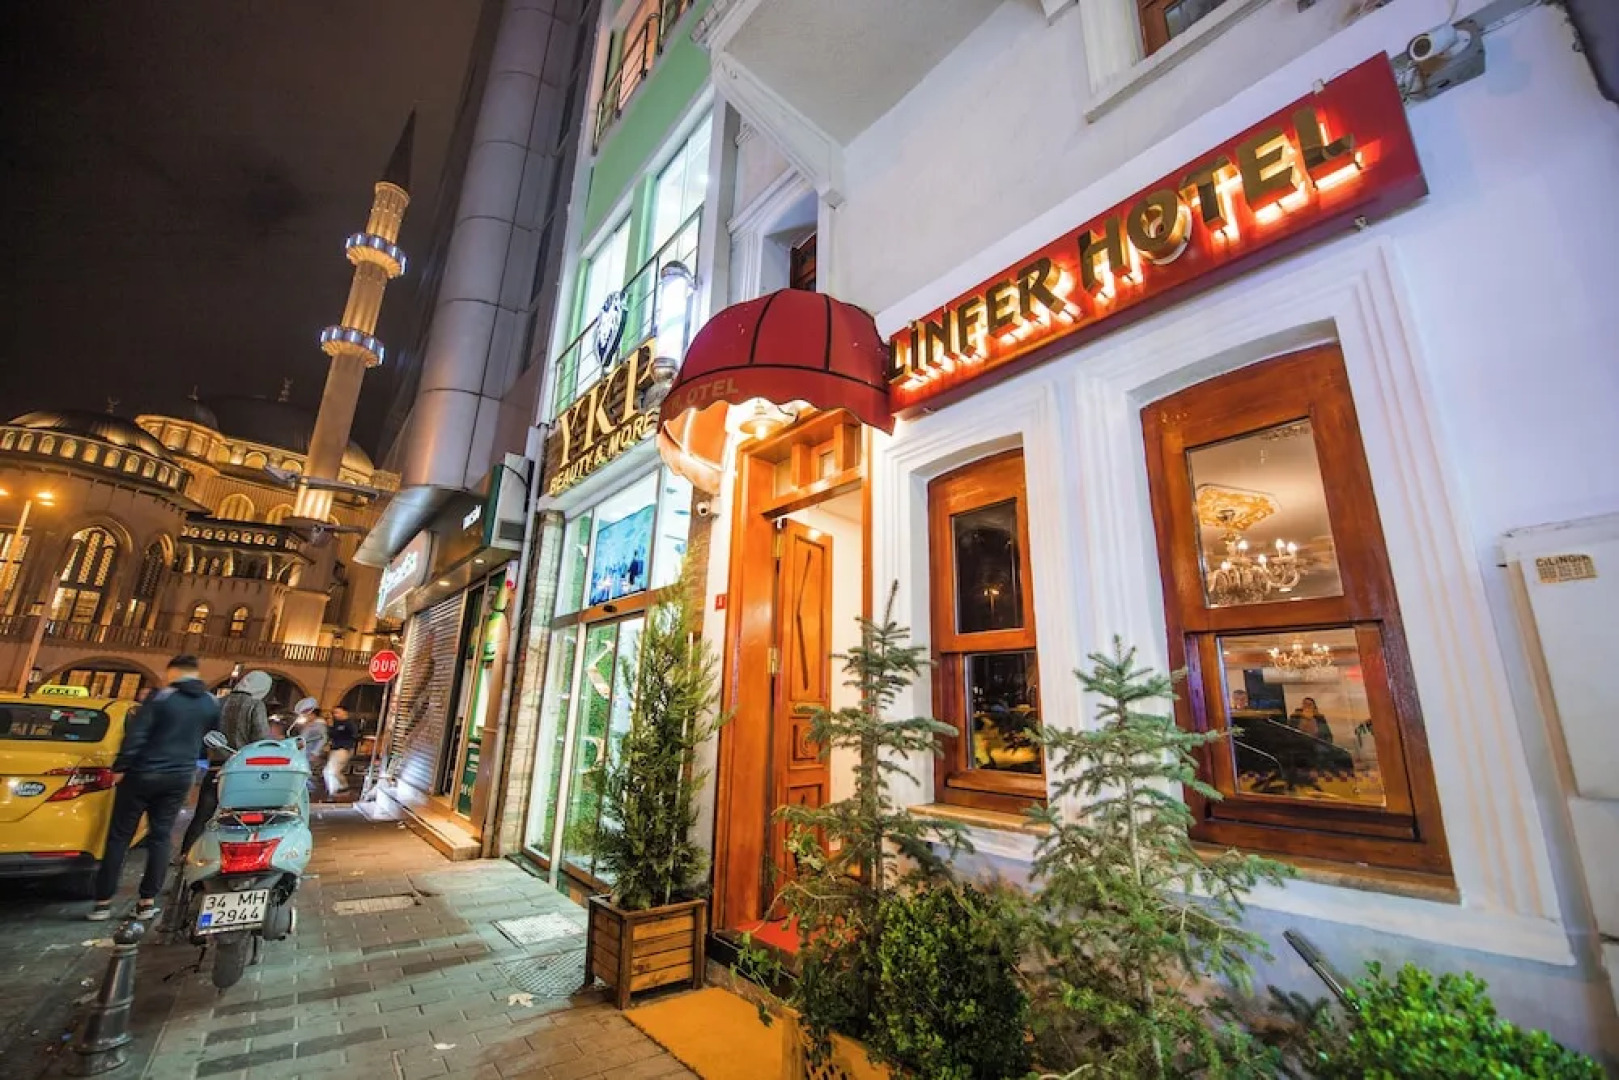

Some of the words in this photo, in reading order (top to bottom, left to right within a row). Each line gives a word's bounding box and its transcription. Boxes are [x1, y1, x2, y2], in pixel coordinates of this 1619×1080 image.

[1077, 104, 1356, 293] HOTEL
[372, 659, 397, 673] DUR
[205, 894, 226, 910] 34
[237, 890, 266, 907] MH
[214, 906, 260, 924] 2944
